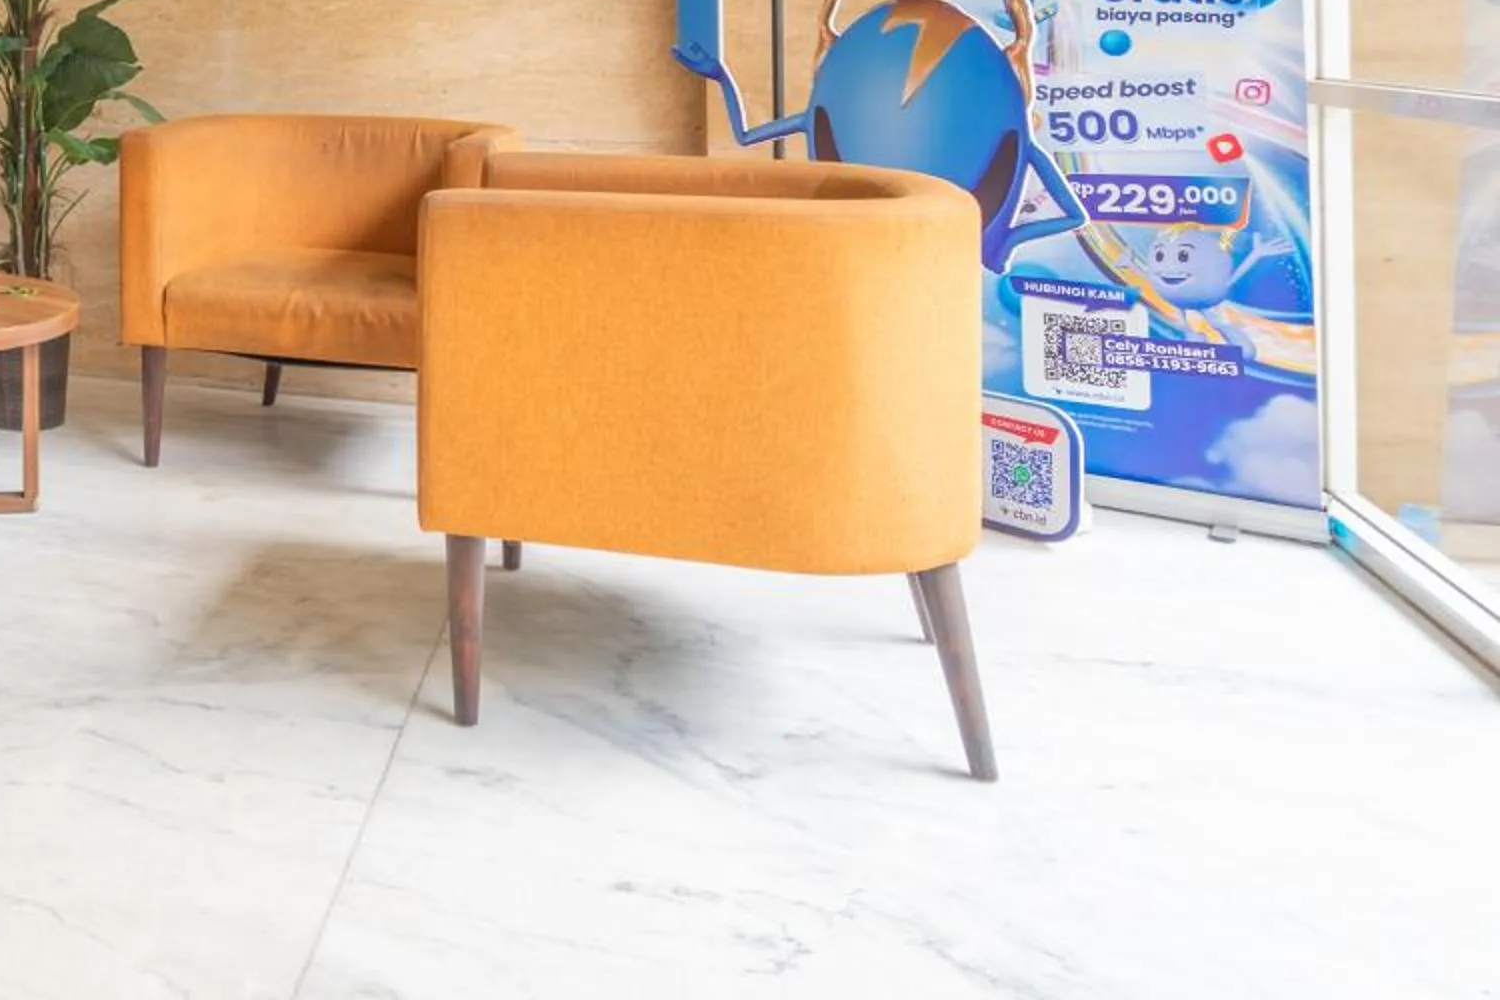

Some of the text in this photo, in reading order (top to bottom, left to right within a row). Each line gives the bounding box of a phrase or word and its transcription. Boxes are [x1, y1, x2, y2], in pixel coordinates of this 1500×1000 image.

[1096, 7, 1152, 25] biaya
[1035, 78, 1197, 105] Speed boost
[1049, 109, 1139, 143] 500
[1070, 181, 1094, 199] Rp
[1023, 281, 1125, 301] HUBUNGI KAMI
[1105, 338, 1141, 356] Cely
[1013, 508, 1047, 526] cbn.id
